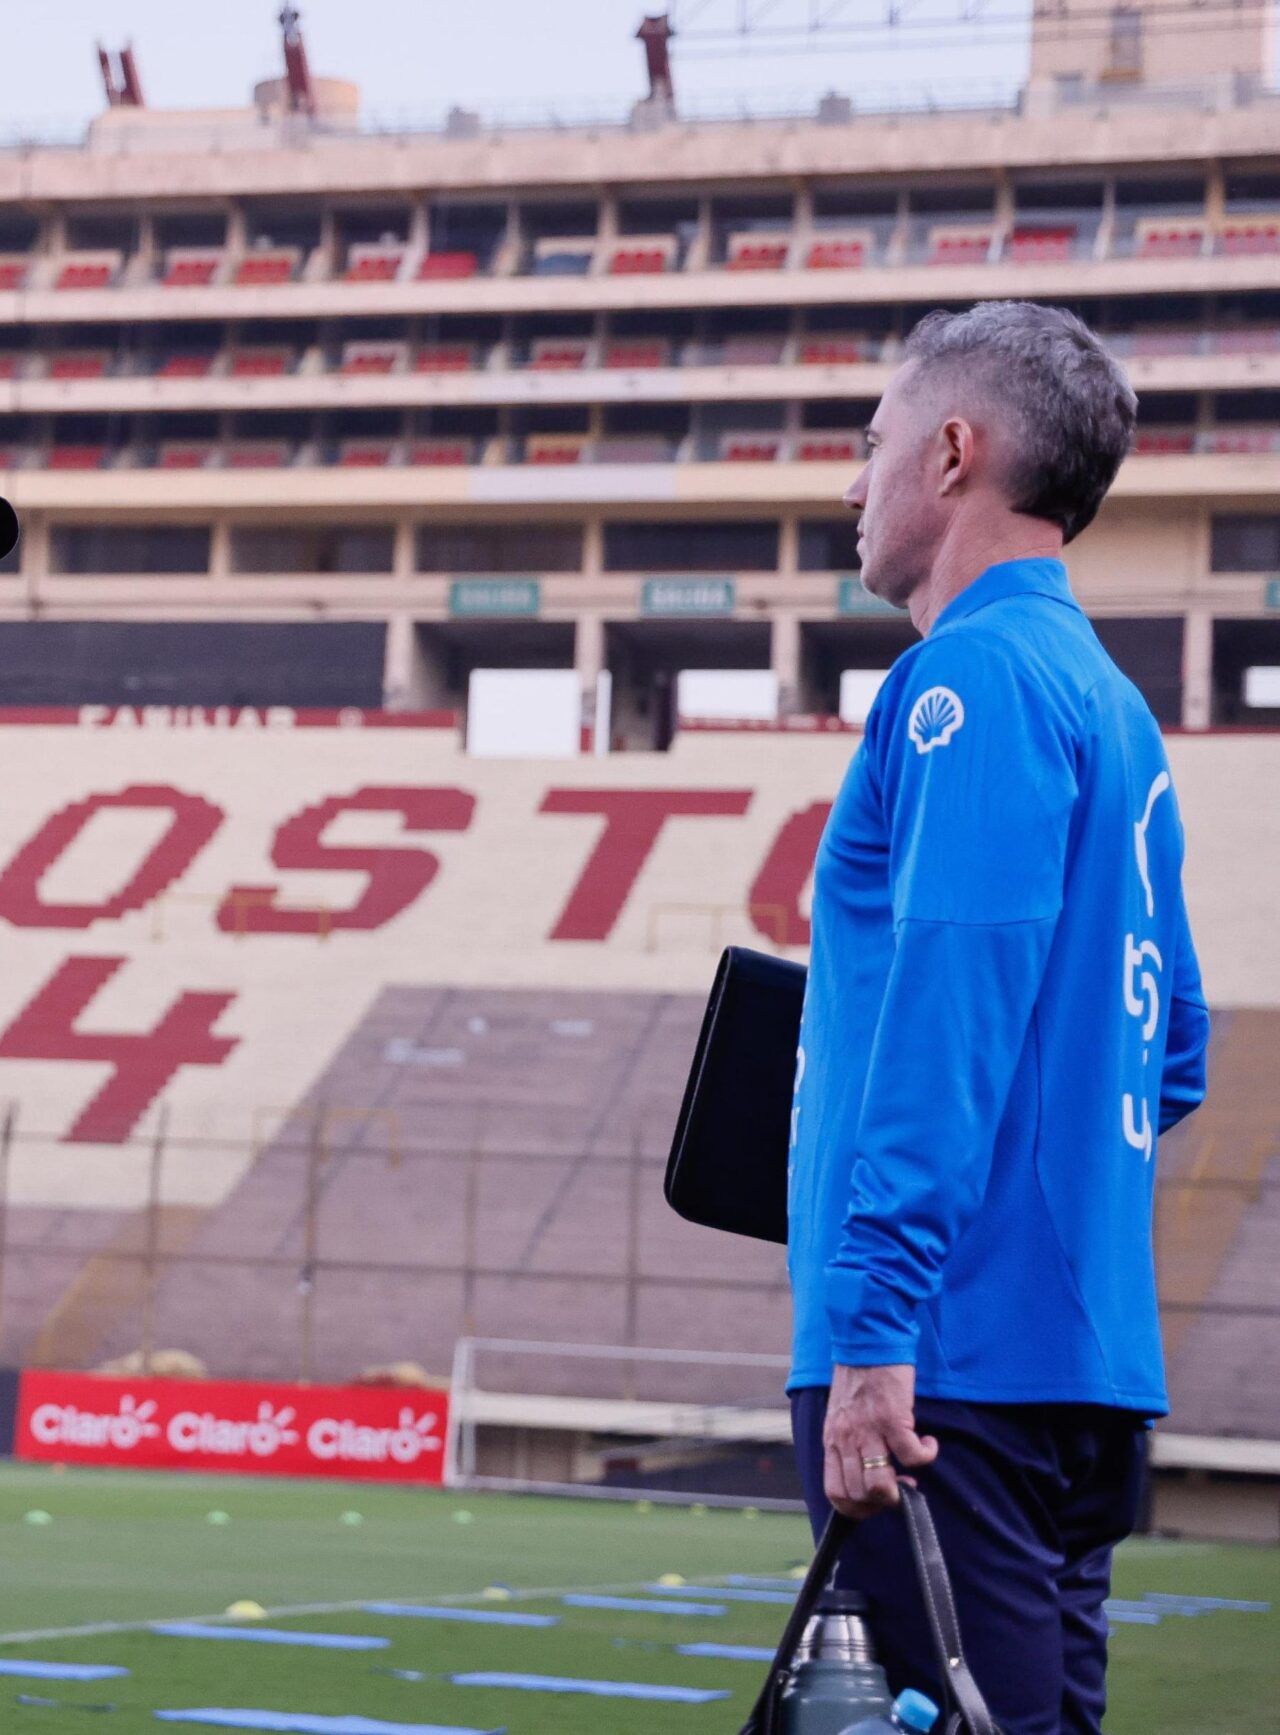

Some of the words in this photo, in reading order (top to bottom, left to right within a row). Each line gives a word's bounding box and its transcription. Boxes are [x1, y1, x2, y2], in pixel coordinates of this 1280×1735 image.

[30, 1403, 143, 1450] Claro
[167, 1410, 282, 1457] Claro
[307, 1418, 423, 1464] Claro
